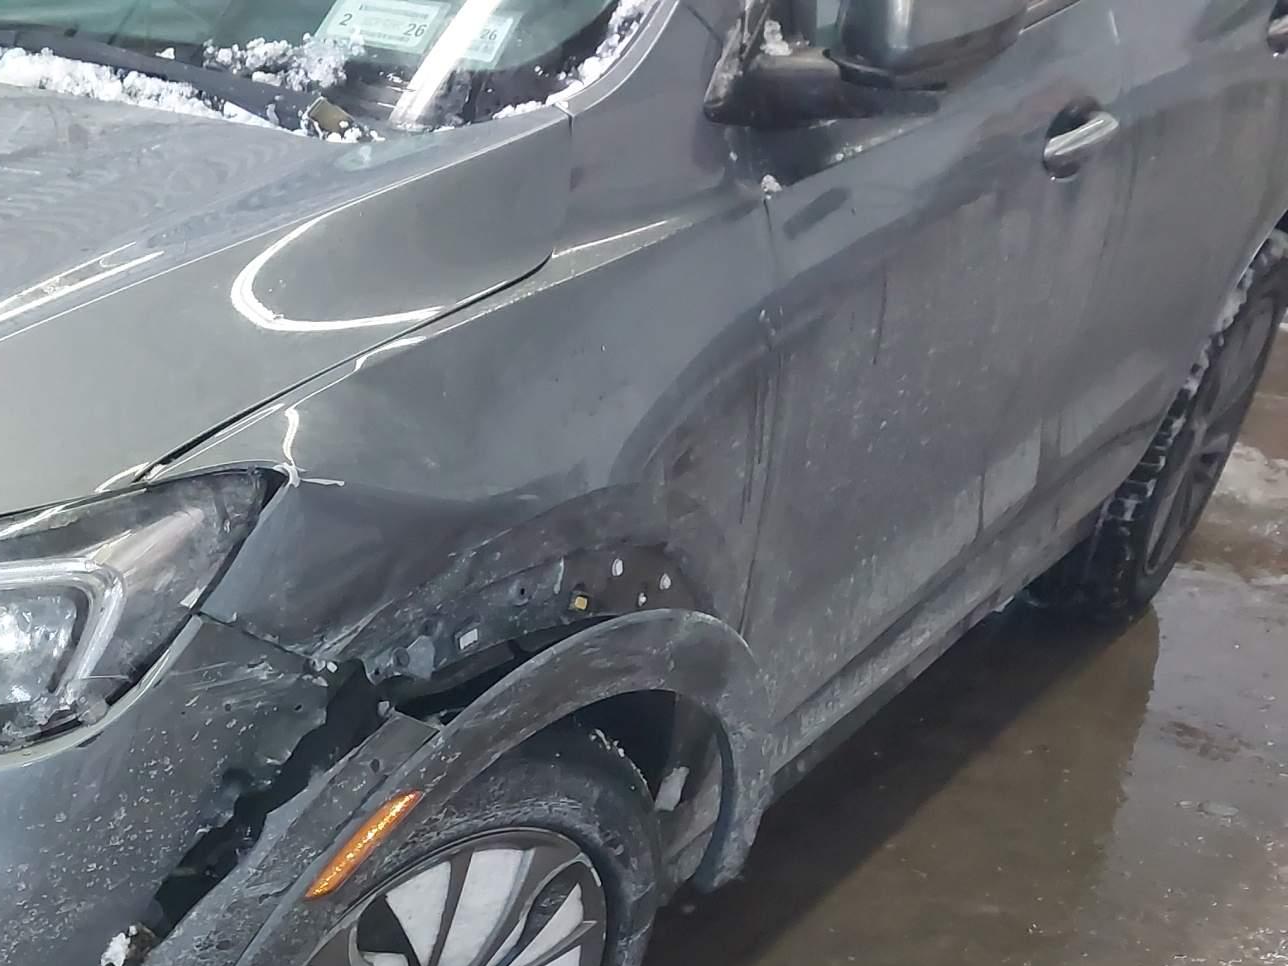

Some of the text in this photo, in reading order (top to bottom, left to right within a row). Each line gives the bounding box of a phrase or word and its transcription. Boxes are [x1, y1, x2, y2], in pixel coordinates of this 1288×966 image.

[339, 13, 353, 26] 2
[403, 23, 427, 37] 26
[480, 28, 498, 41] 26
